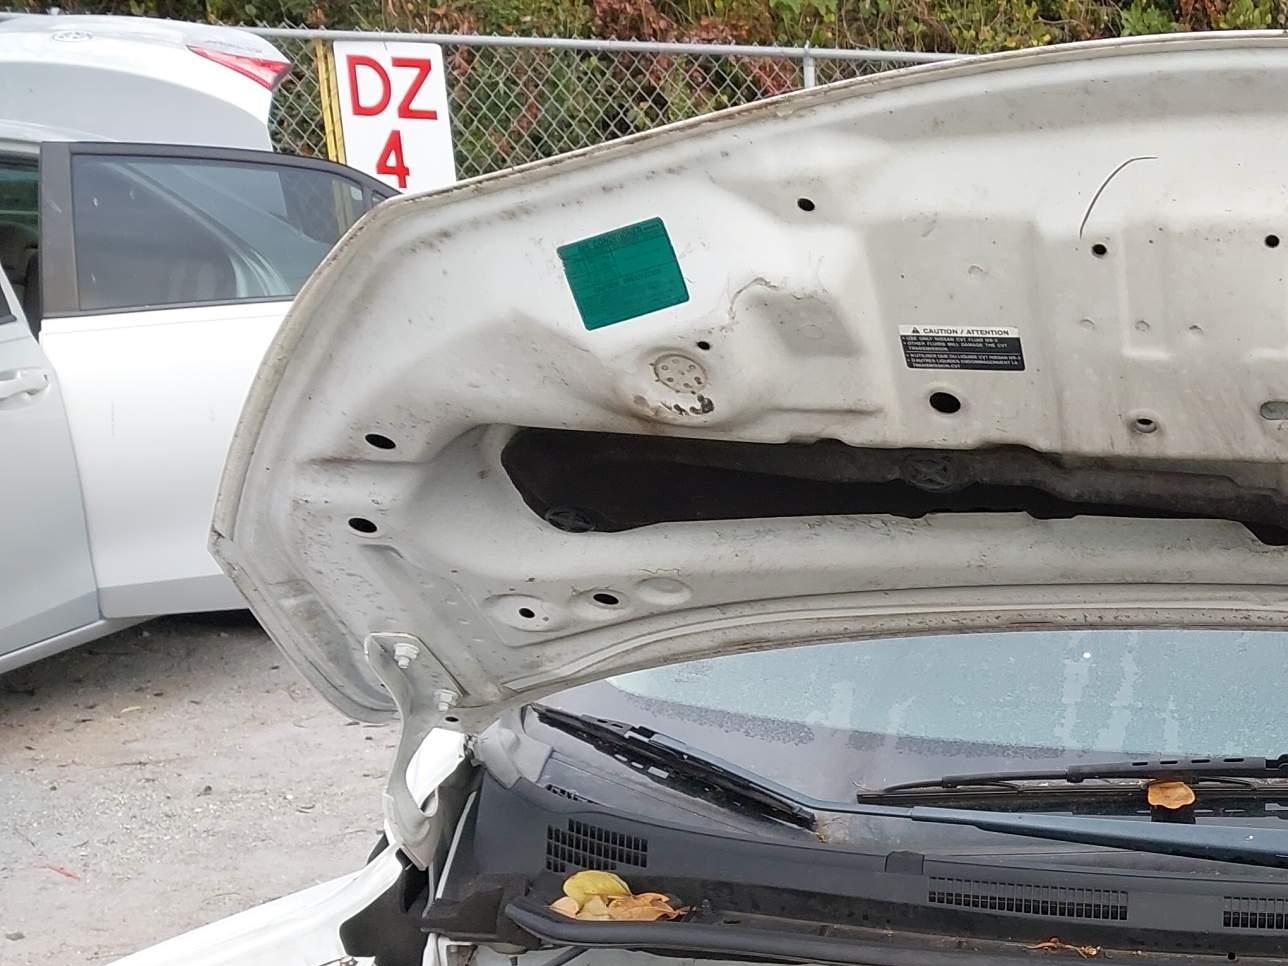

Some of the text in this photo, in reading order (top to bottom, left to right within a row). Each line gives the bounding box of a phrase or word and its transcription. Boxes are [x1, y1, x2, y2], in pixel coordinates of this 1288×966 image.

[346, 54, 438, 121] DZ
[375, 129, 411, 190] 4
[966, 328, 1009, 336] ATTENTION
